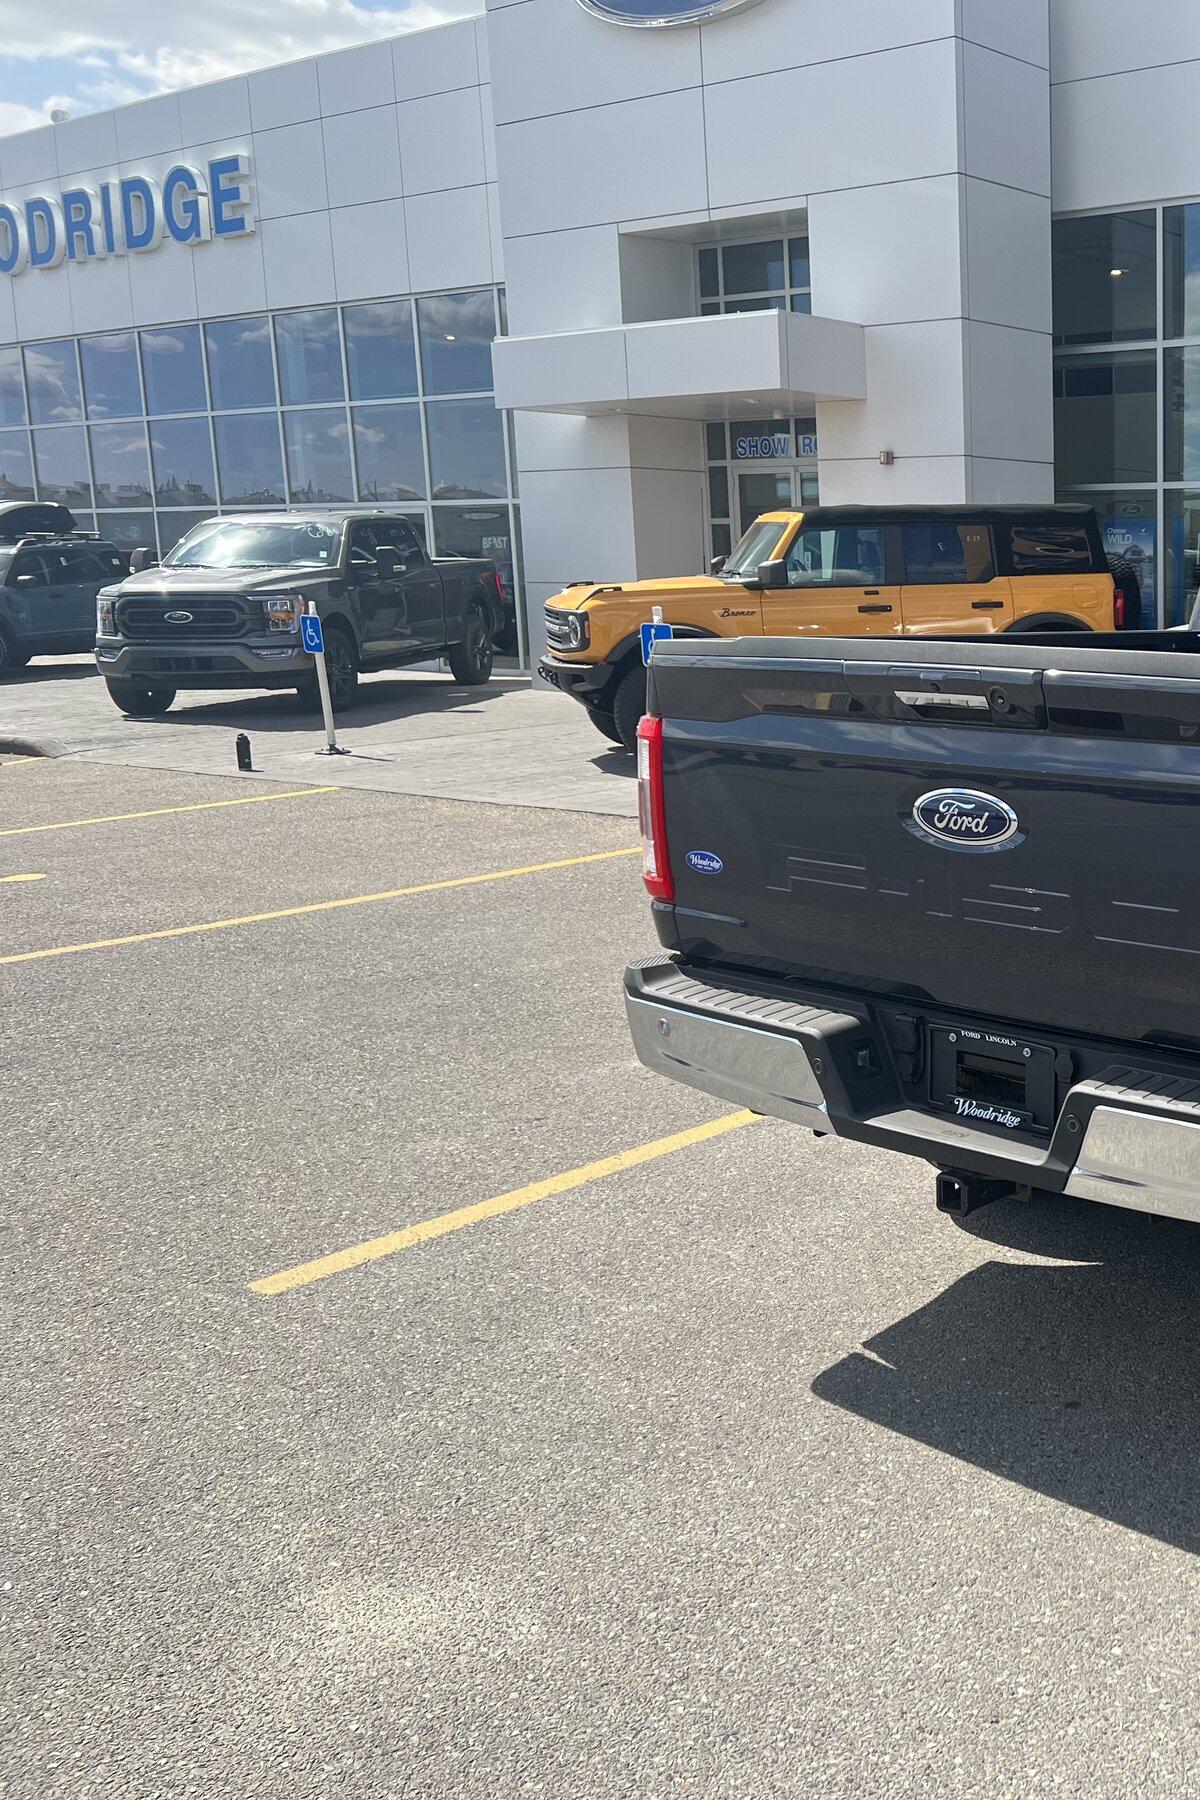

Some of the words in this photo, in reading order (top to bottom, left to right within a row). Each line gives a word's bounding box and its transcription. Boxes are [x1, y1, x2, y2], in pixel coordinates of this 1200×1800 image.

[736, 434, 789, 457] SHOW
[1107, 534, 1133, 544] WILD
[720, 607, 757, 617] Bronco
[934, 799, 989, 833] Ford
[961, 1030, 981, 1039] FORD
[985, 1034, 1017, 1047] LINCOLN
[954, 1097, 1021, 1128] Woodridge
